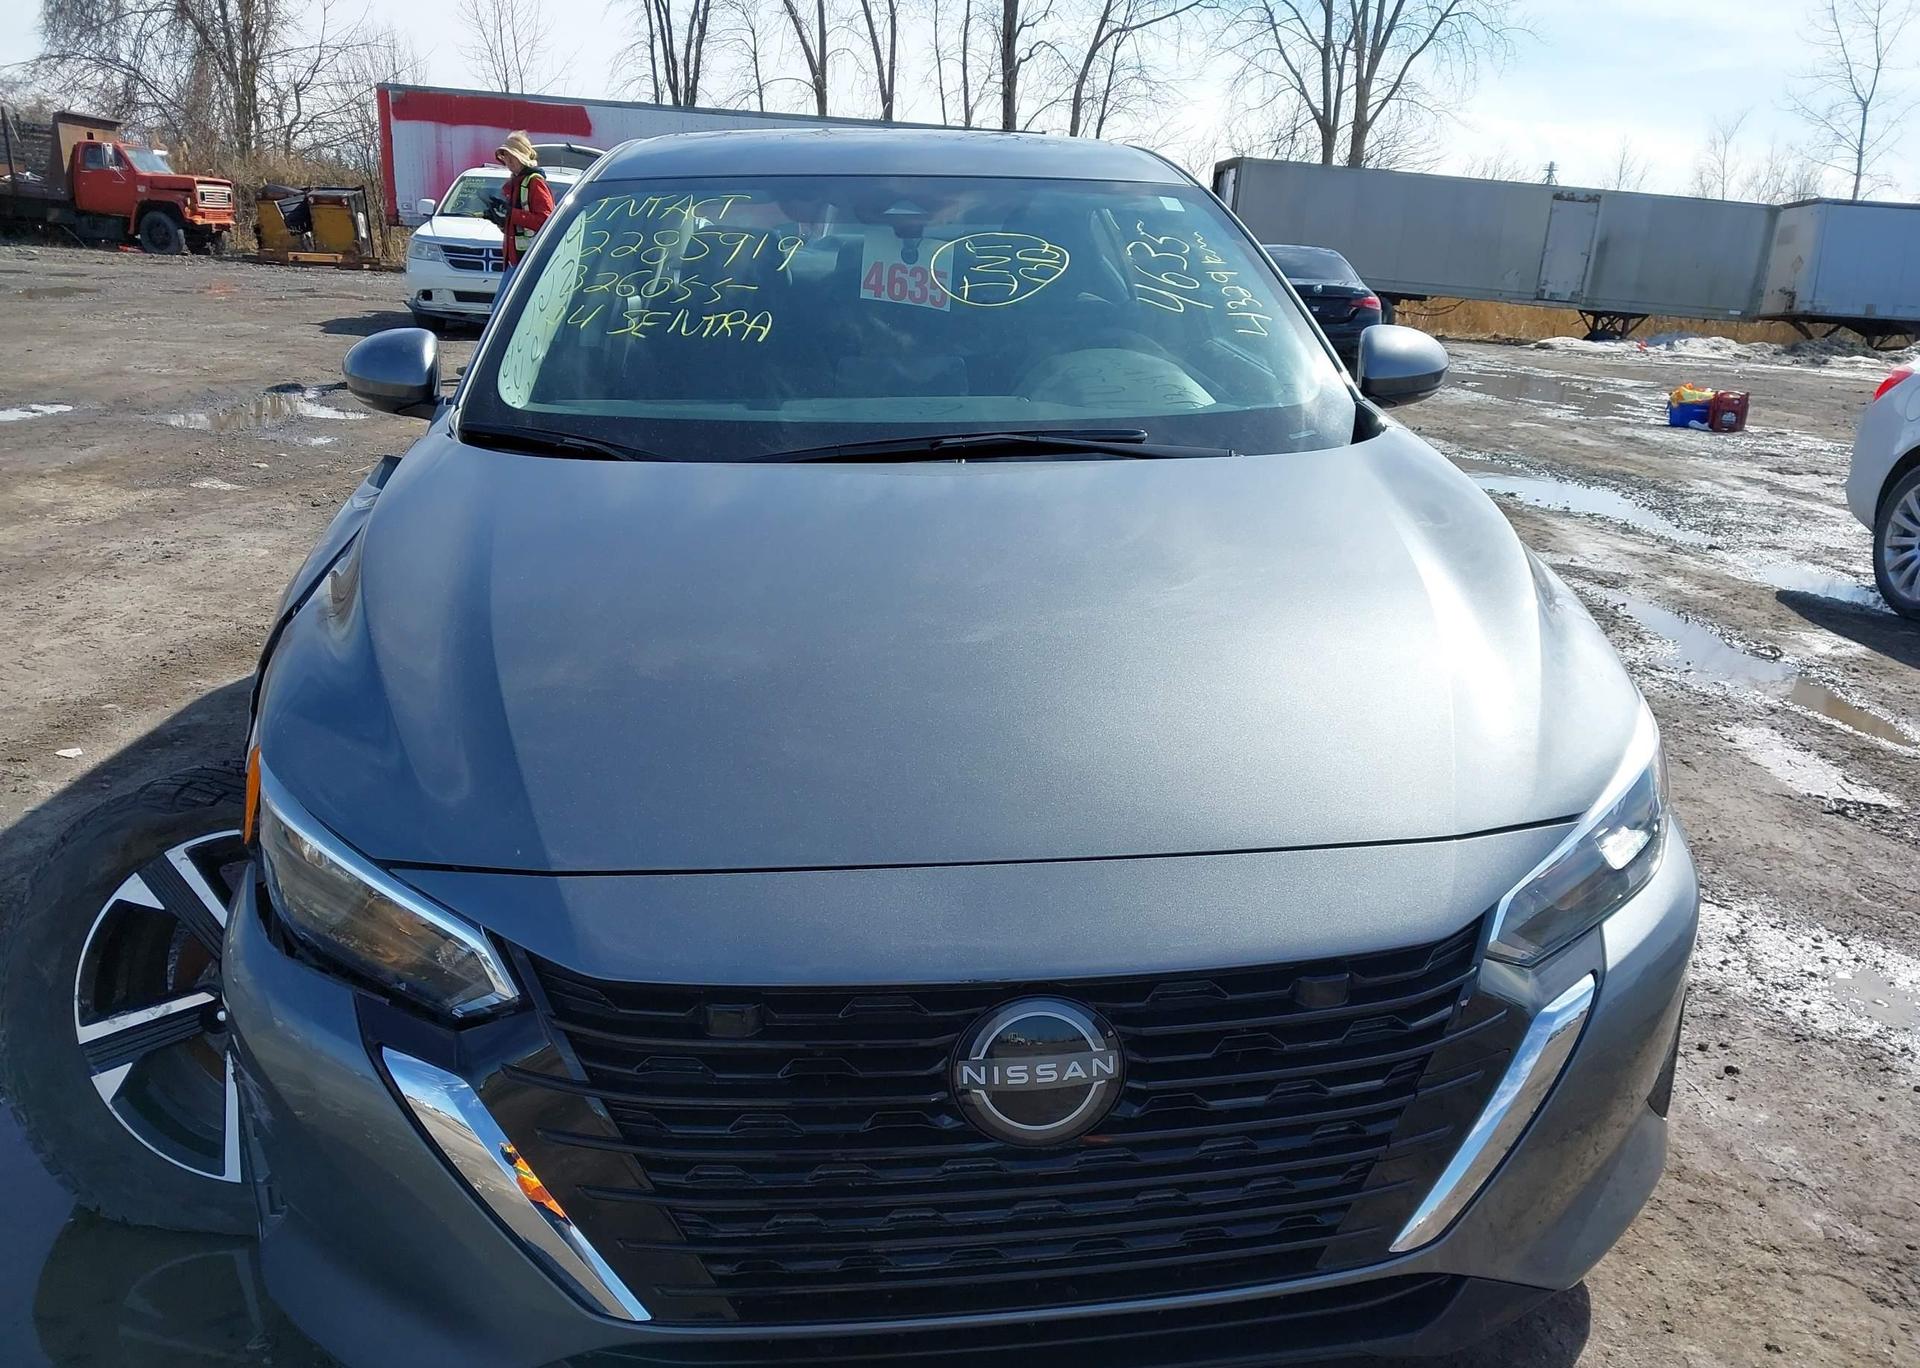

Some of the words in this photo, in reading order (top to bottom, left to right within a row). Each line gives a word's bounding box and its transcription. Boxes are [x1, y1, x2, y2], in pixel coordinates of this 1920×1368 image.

[584, 193, 751, 222] INTACT
[1127, 219, 1215, 313] 4635
[862, 260, 948, 309] 4635
[606, 309, 773, 343] SENTRA
[962, 1055, 1115, 1085] NISSAN
